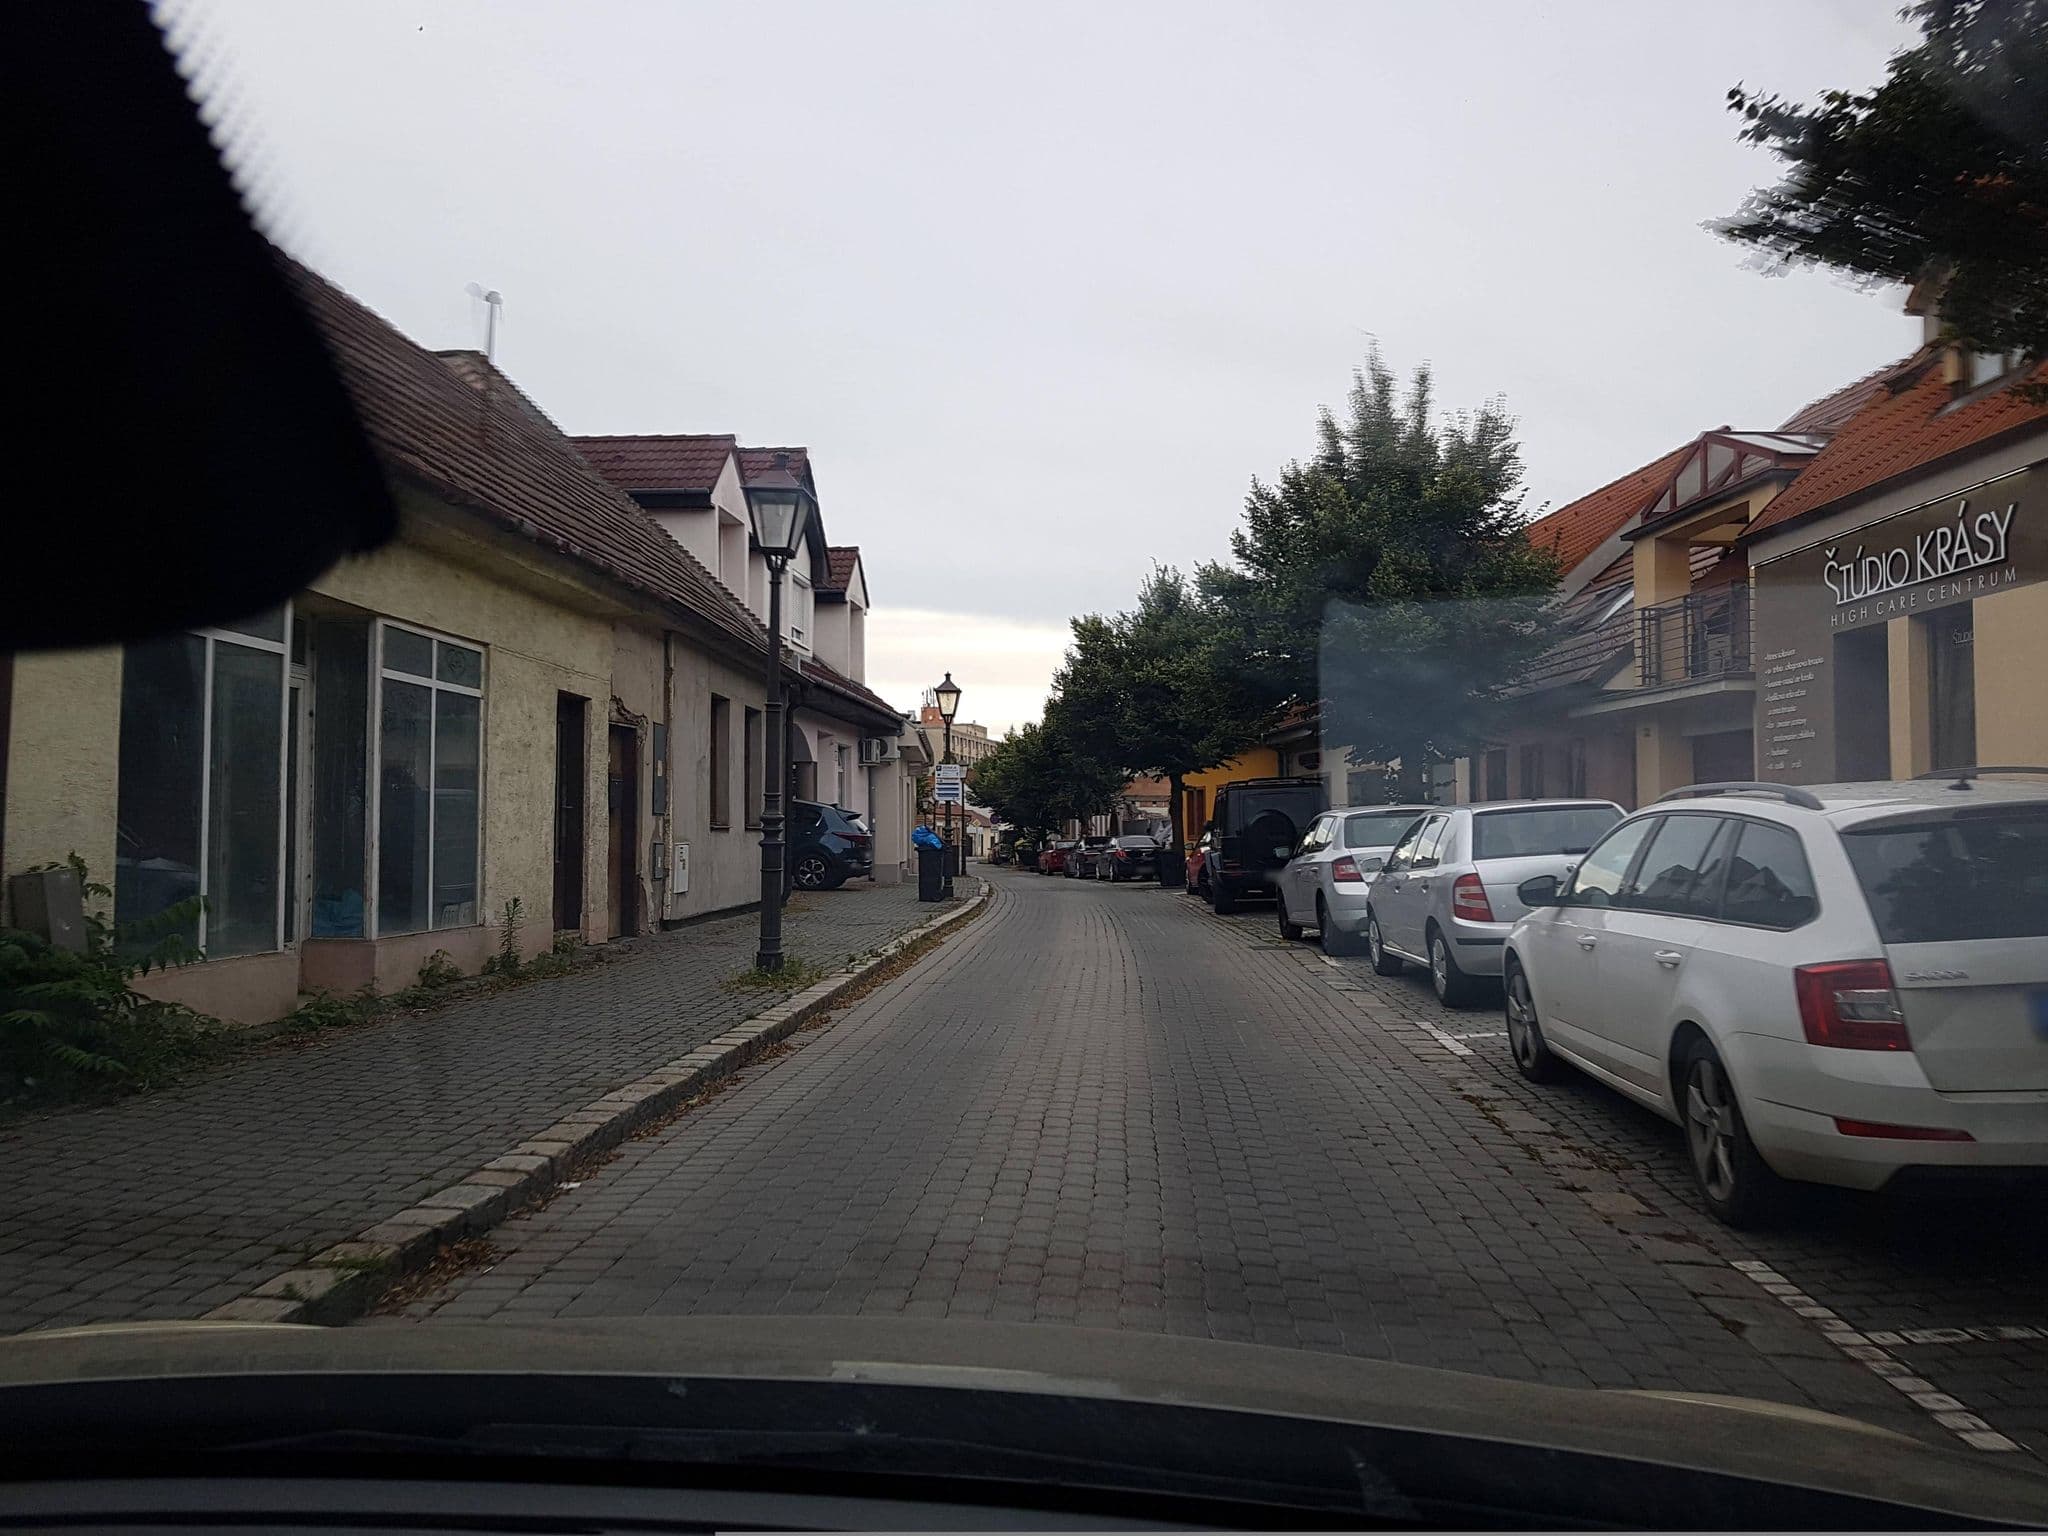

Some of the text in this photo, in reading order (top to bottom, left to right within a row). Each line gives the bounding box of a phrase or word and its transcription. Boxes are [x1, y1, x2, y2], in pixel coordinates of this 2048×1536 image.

[1823, 500, 2015, 605] ŠTÚDIO KRÁSY
[1831, 566, 2016, 627] HIGH CARE CENTRUM
